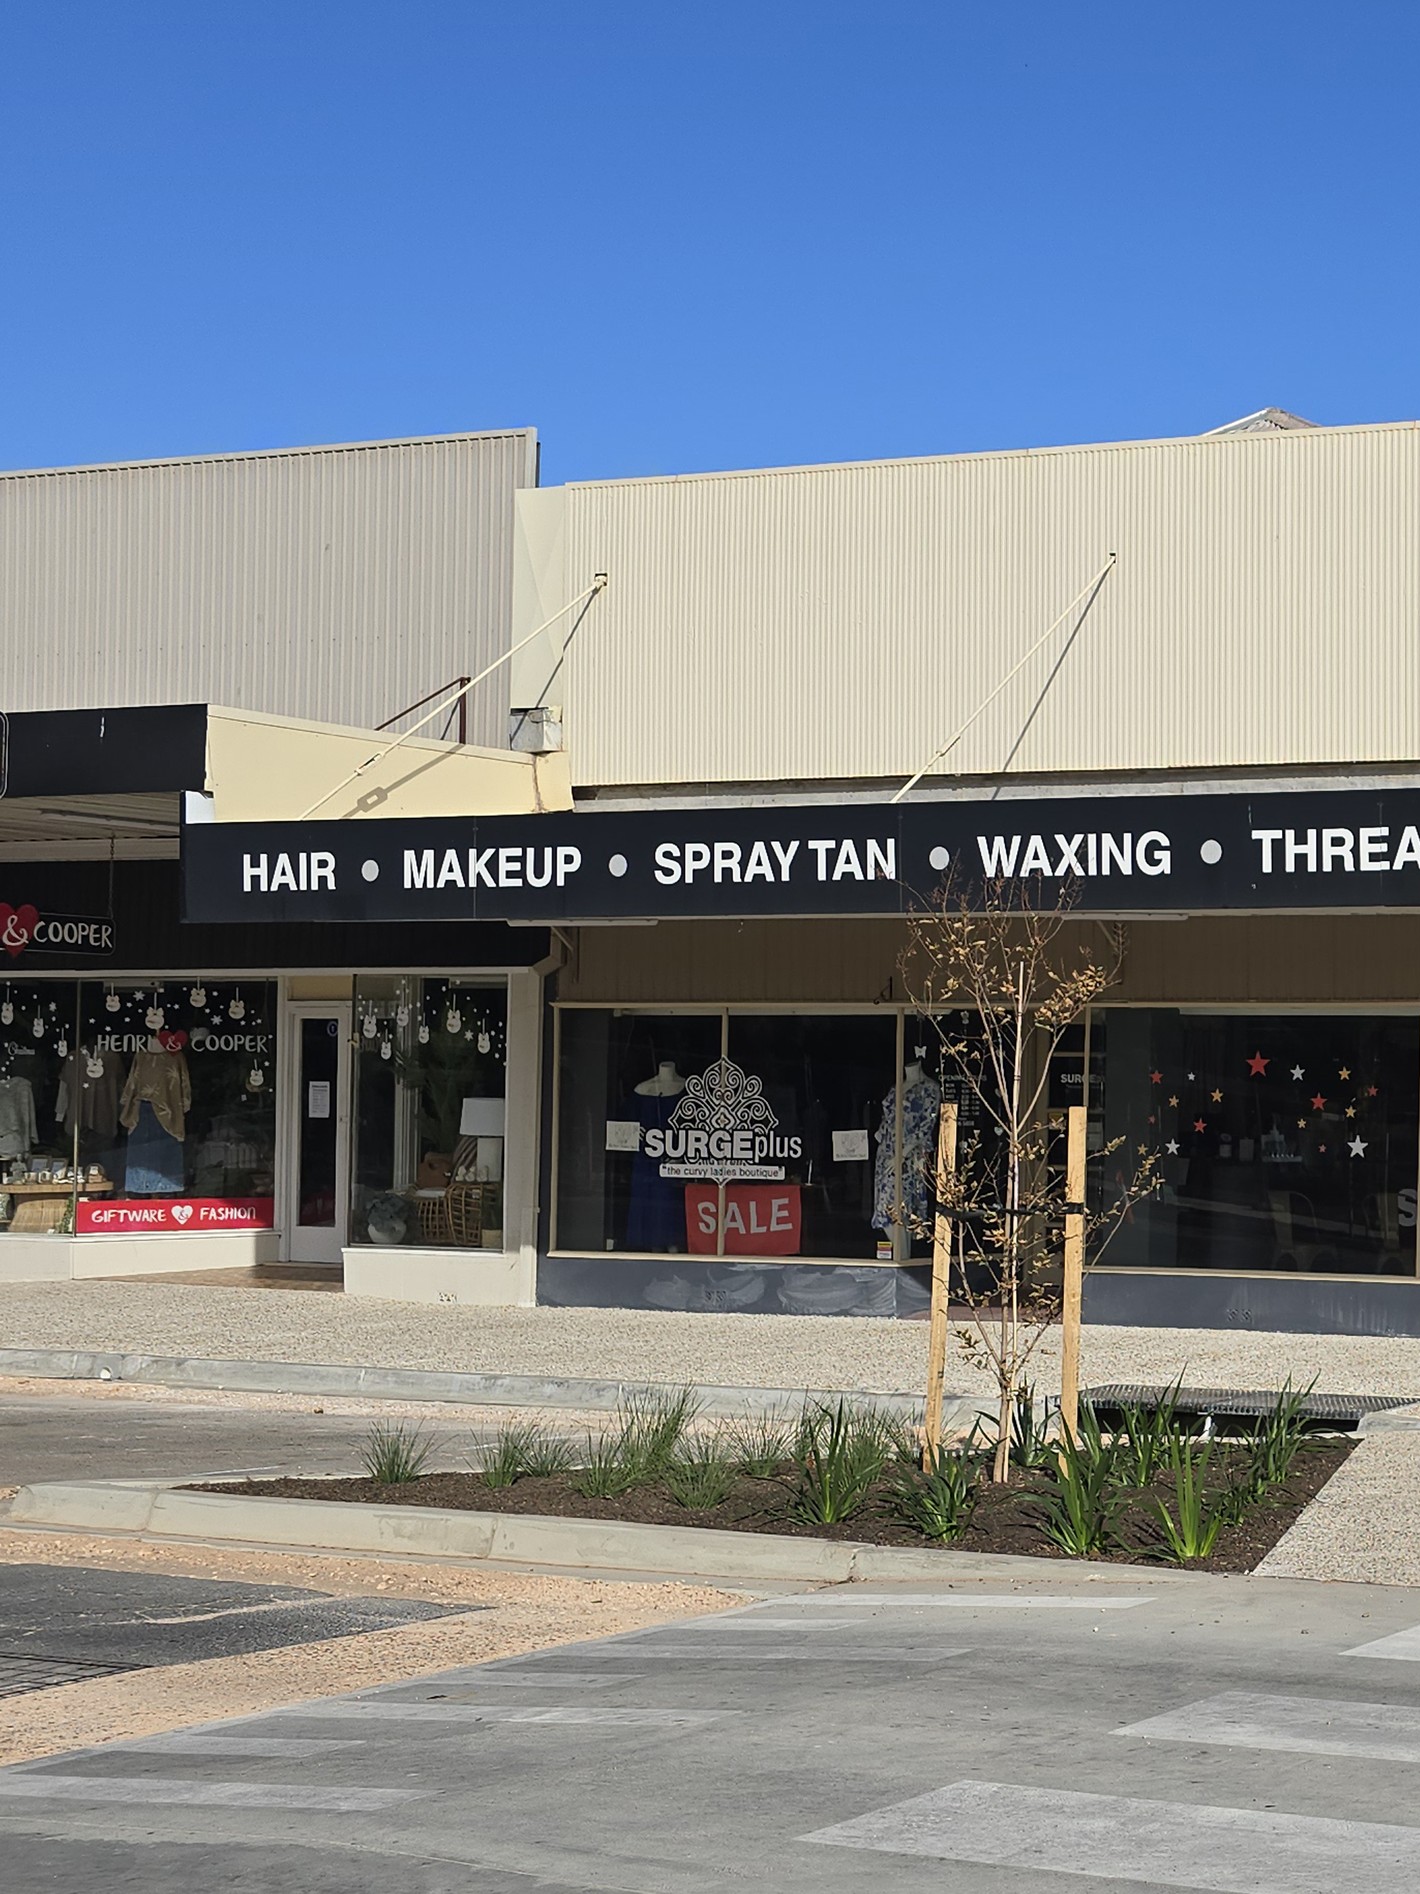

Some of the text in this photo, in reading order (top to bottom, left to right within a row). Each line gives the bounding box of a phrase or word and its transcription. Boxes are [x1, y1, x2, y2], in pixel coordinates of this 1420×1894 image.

[243, 851, 337, 892] HAIR
[403, 846, 582, 889] MAKEUP
[653, 840, 800, 885] SPRAY
[807, 838, 897, 881] TAN
[976, 830, 1171, 878] WAXING
[2, 914, 113, 949] & COOPER
[165, 1035, 182, 1052] &
[191, 1034, 269, 1053] COOPER
[684, 1166, 707, 1177] curvy
[710, 1164, 737, 1177] ladies
[91, 1209, 167, 1223] GIFTWARE
[199, 1206, 257, 1221] FASHION
[697, 1198, 793, 1235] SALE
